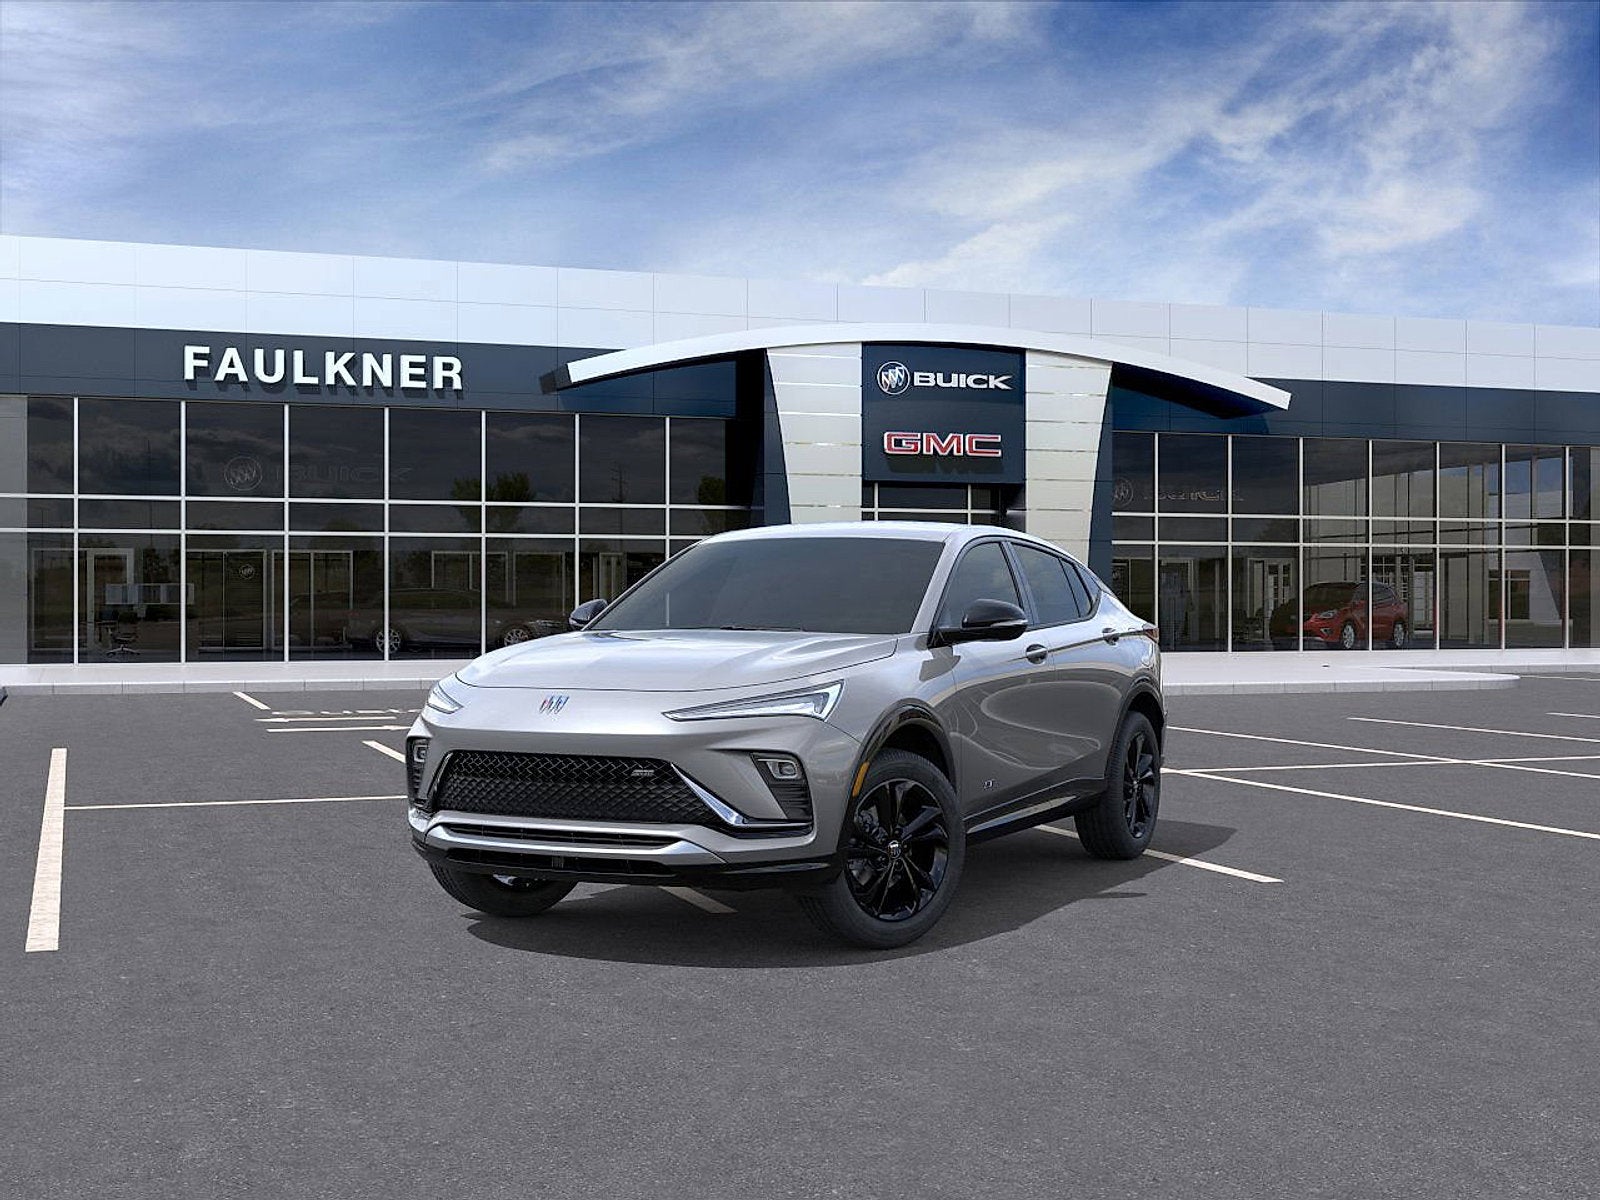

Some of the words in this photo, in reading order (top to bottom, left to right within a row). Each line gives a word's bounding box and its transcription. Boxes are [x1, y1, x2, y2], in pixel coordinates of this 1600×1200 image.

[183, 345, 463, 390] FAULKNER
[913, 372, 1013, 390] BUICK
[883, 431, 1002, 458] GMC
